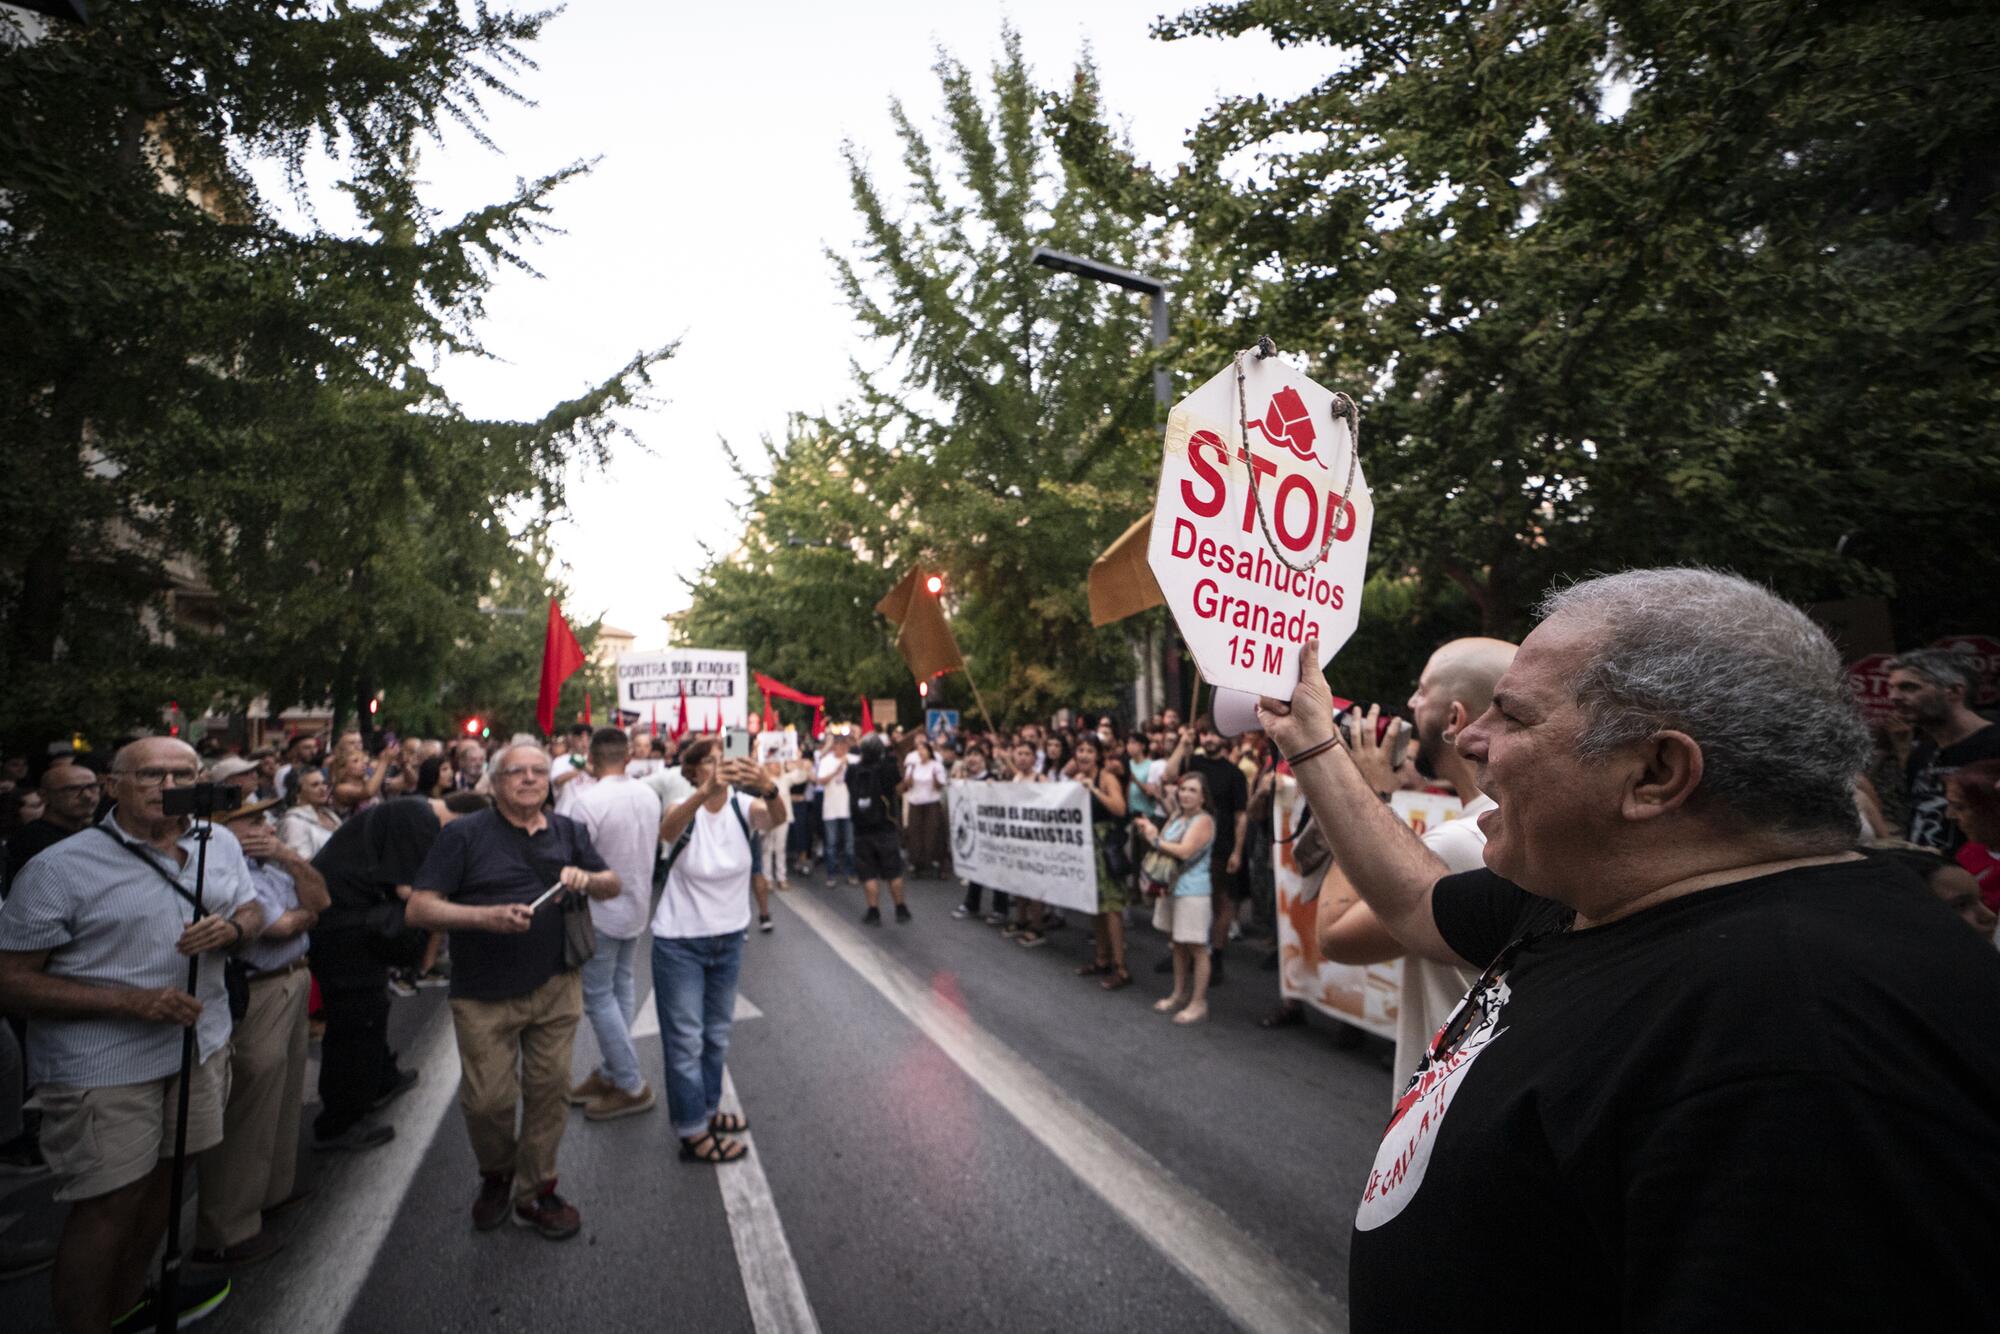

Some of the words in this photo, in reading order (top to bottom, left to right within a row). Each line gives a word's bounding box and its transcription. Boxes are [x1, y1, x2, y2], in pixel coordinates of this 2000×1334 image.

[1180, 429, 1356, 563] STOP
[1171, 517, 1344, 611] Desahucios
[1192, 578, 1320, 644] Granada
[619, 662, 667, 678] CONTRA
[696, 661, 741, 676] ATAQUES
[1228, 635, 1256, 669] 15
[1262, 644, 1284, 676] M
[1009, 825, 1084, 847] RENTISTAS
[1017, 860, 1086, 881] SINDICATO
